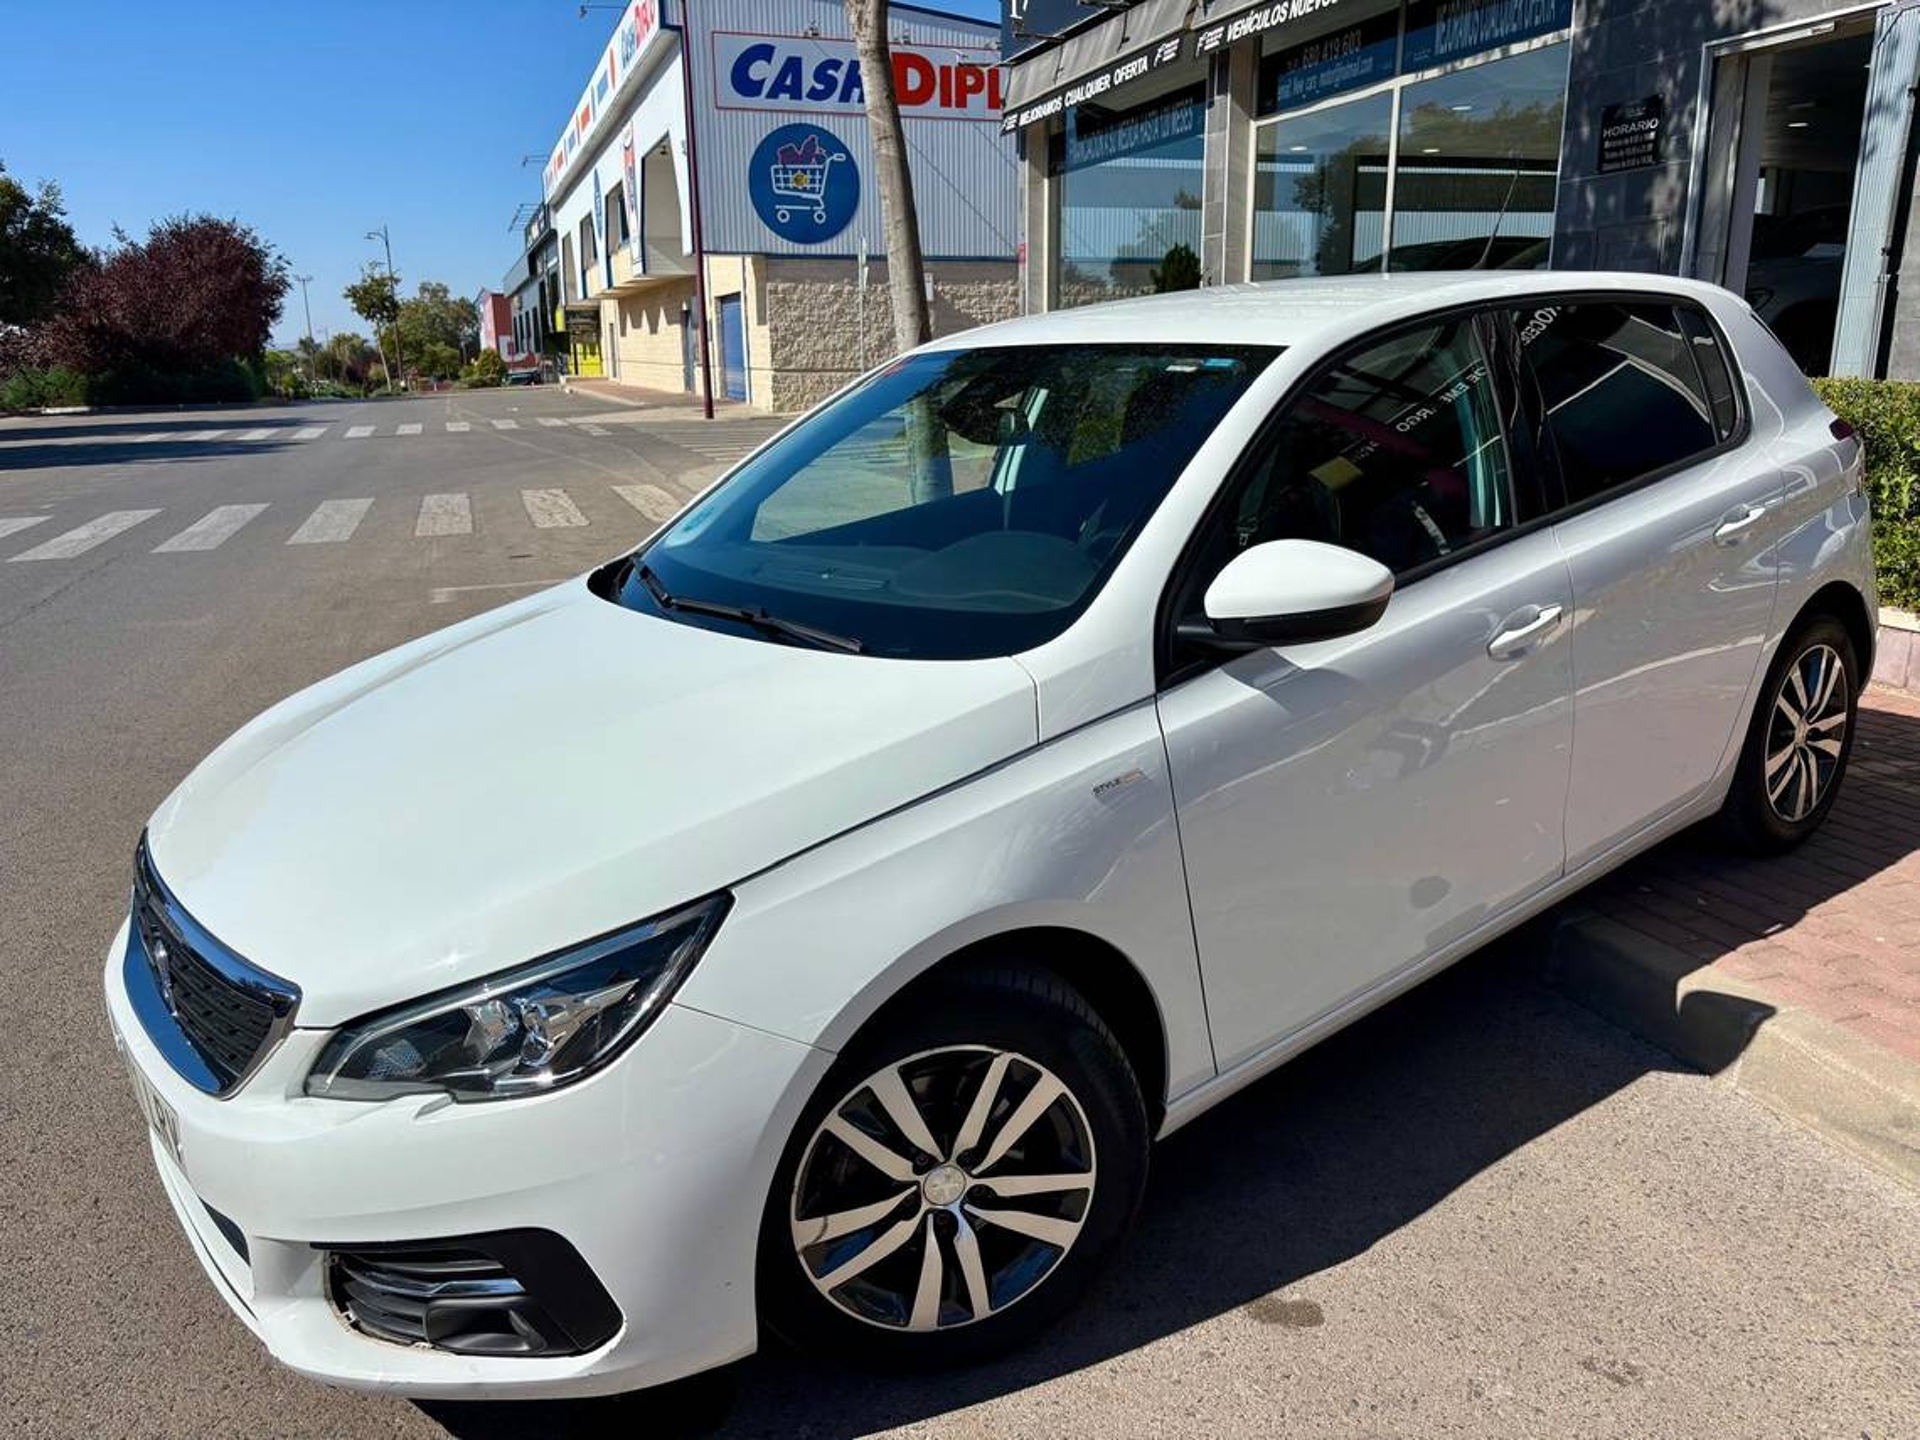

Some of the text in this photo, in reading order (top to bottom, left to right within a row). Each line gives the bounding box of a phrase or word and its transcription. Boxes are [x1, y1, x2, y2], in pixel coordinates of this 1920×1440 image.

[1018, 96, 1063, 127] MEJORAMOS
[1063, 74, 1111, 107] CUALQUIER
[1113, 56, 1149, 88] OFERTA
[1602, 118, 1659, 139] HORARIO
